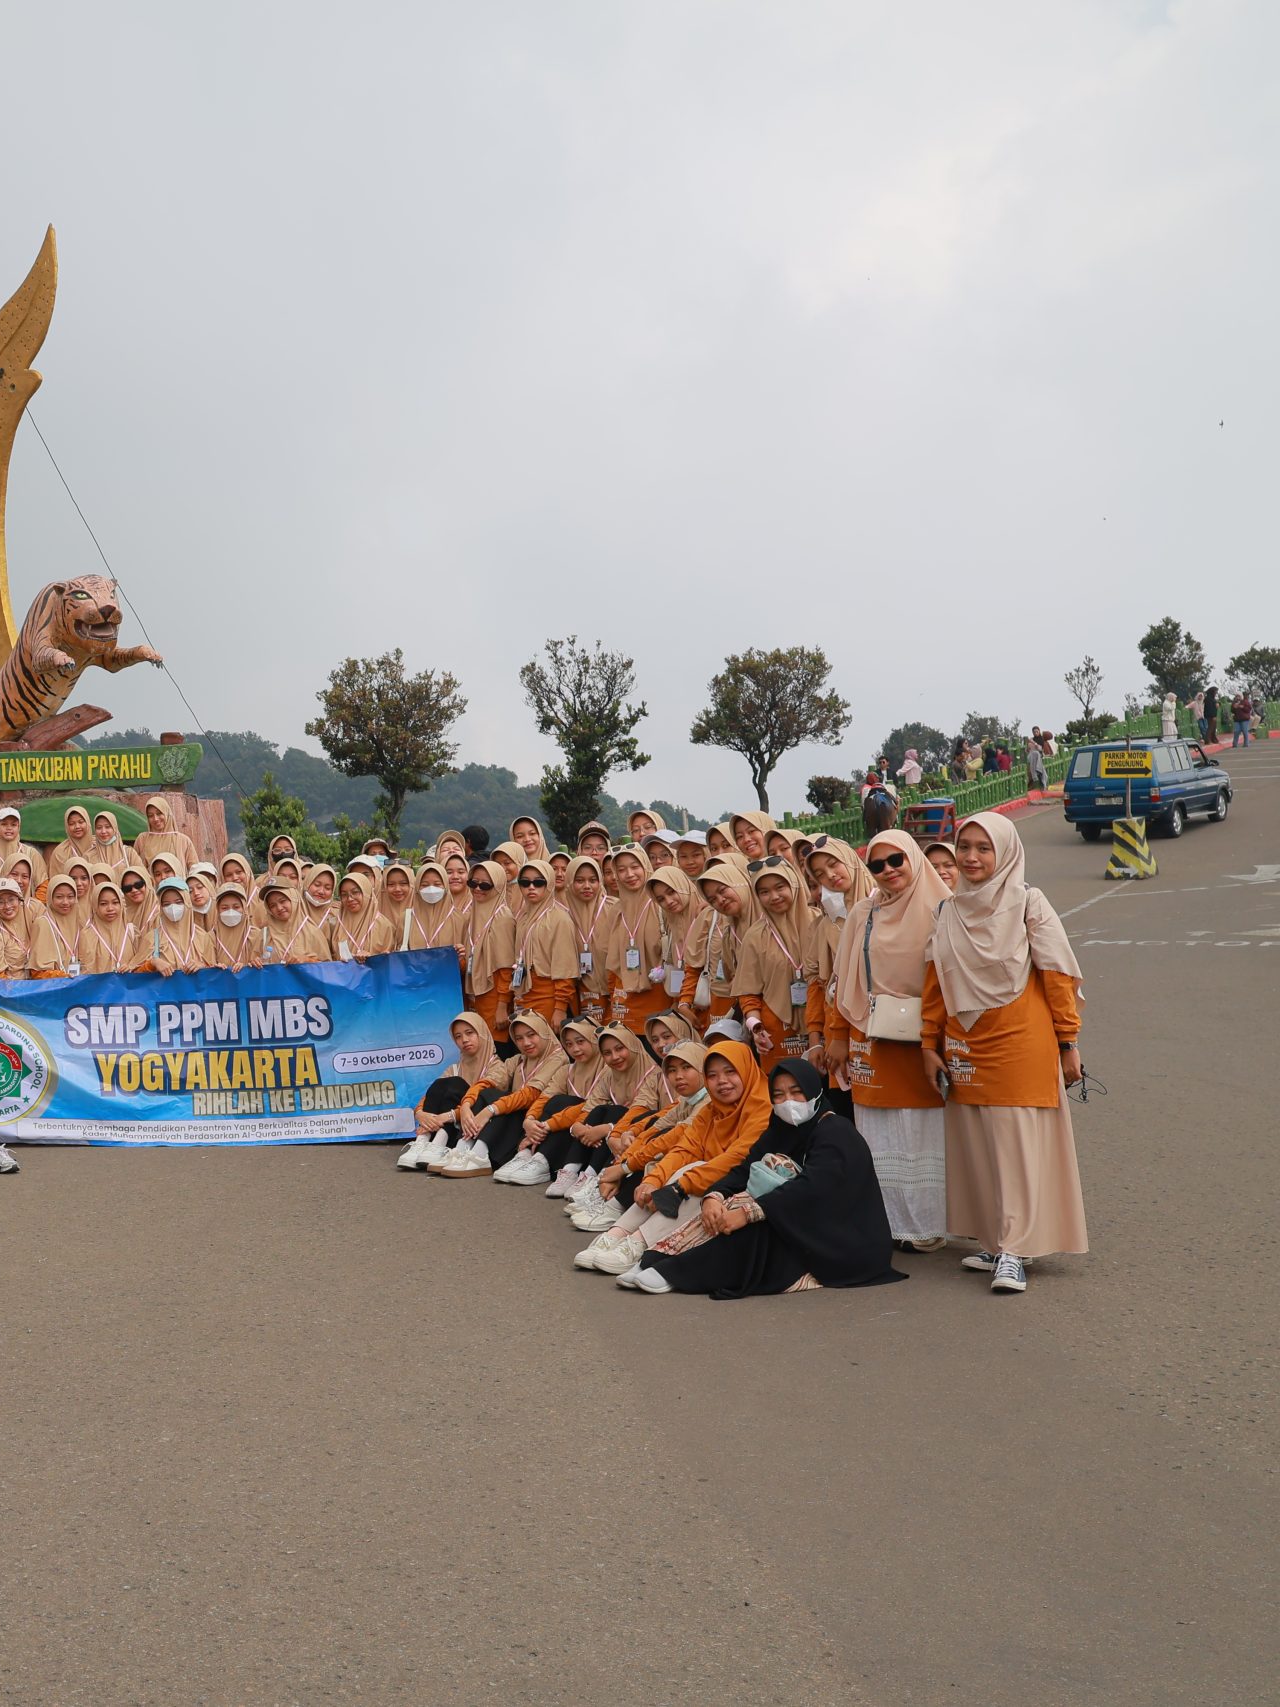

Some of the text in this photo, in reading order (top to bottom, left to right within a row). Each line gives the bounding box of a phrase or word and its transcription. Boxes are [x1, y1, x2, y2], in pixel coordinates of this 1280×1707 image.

[87, 753, 151, 780] PARAHU
[1104, 752, 1147, 760] PARKIR MOTOR
[1107, 760, 1144, 768] PENGUNJUNG
[66, 996, 331, 1045] SMP PPM MBS
[95, 1047, 319, 1092] YOGYAKARTA
[340, 1049, 436, 1067] 7-9 Oktober 2026
[30, 1052, 44, 1091] SCHOOL
[193, 1080, 396, 1115] RIHLAH KE BANDUNG
[33, 1122, 93, 1132] Terbentuknya
[137, 1124, 186, 1133] Pendidikan
[187, 1123, 231, 1133] Pesantren
[234, 1123, 257, 1133] Yang
[258, 1120, 308, 1131] Berkualitas
[309, 1118, 339, 1128] Dalam
[340, 1113, 395, 1126] Menyiapkan
[110, 1131, 182, 1141] Muhammadiyah
[183, 1131, 240, 1141] Berdasarkan
[241, 1130, 283, 1140] Al-Quran
[284, 1128, 302, 1137] dan
[303, 1125, 348, 1136] As-Sunah
